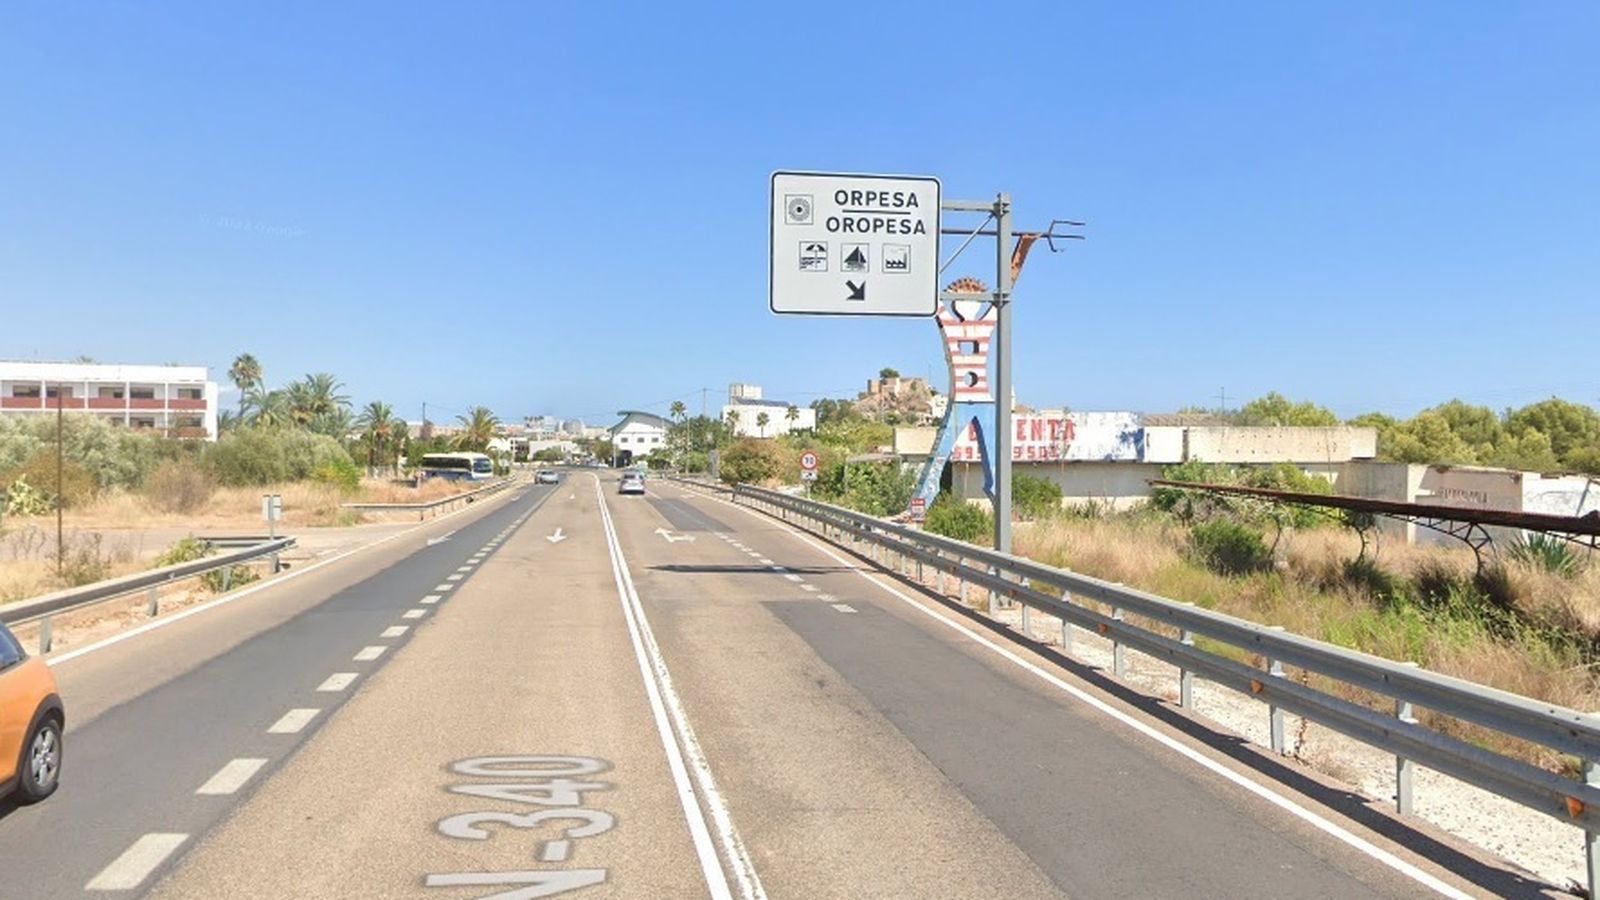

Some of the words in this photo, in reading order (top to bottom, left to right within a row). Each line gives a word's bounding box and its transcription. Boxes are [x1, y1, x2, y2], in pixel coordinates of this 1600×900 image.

[834, 189, 919, 208] ORPESA
[826, 216, 926, 235] OROPESA
[1016, 418, 1075, 441] ENTA
